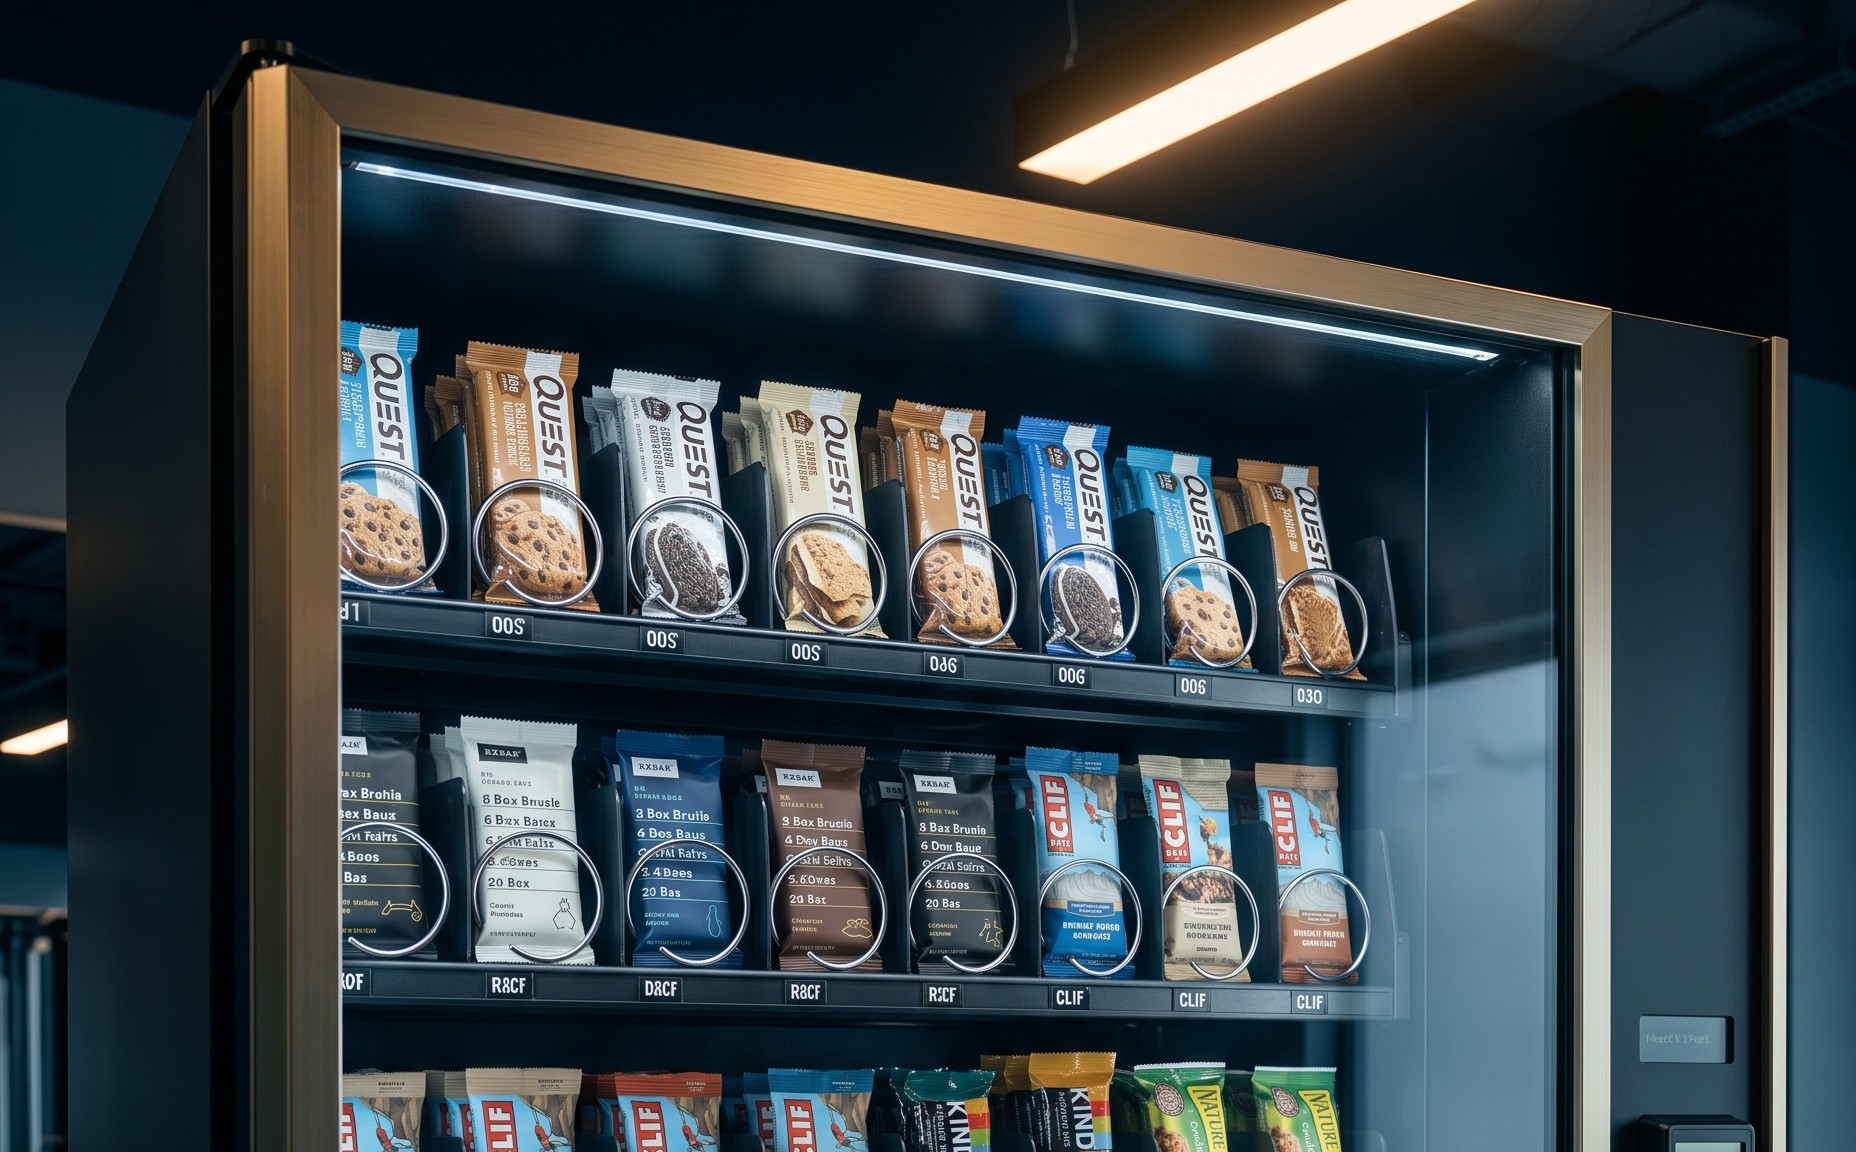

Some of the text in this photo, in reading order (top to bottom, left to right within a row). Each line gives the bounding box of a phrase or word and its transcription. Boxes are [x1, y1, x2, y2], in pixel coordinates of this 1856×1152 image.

[370, 353, 406, 463] QUEST
[533, 374, 567, 478] QUEST
[676, 401, 712, 498] QUEST
[819, 414, 854, 513] QUEST
[950, 433, 982, 529] QUEST
[1073, 448, 1105, 541] QUEST
[1183, 475, 1218, 558] QUEST
[1294, 486, 1328, 569] QUEST
[1045, 781, 1069, 838] CLIF
[1158, 784, 1186, 848] CLIF
[1273, 795, 1296, 852] CLIF
[1056, 990, 1083, 1005] CLIF
[1179, 992, 1206, 1008] CLIF
[1297, 995, 1324, 1010] CLIF
[1071, 1088, 1095, 1150] KIND
[1193, 1089, 1225, 1150] NATURE
[1304, 1092, 1339, 1152] NATURE
